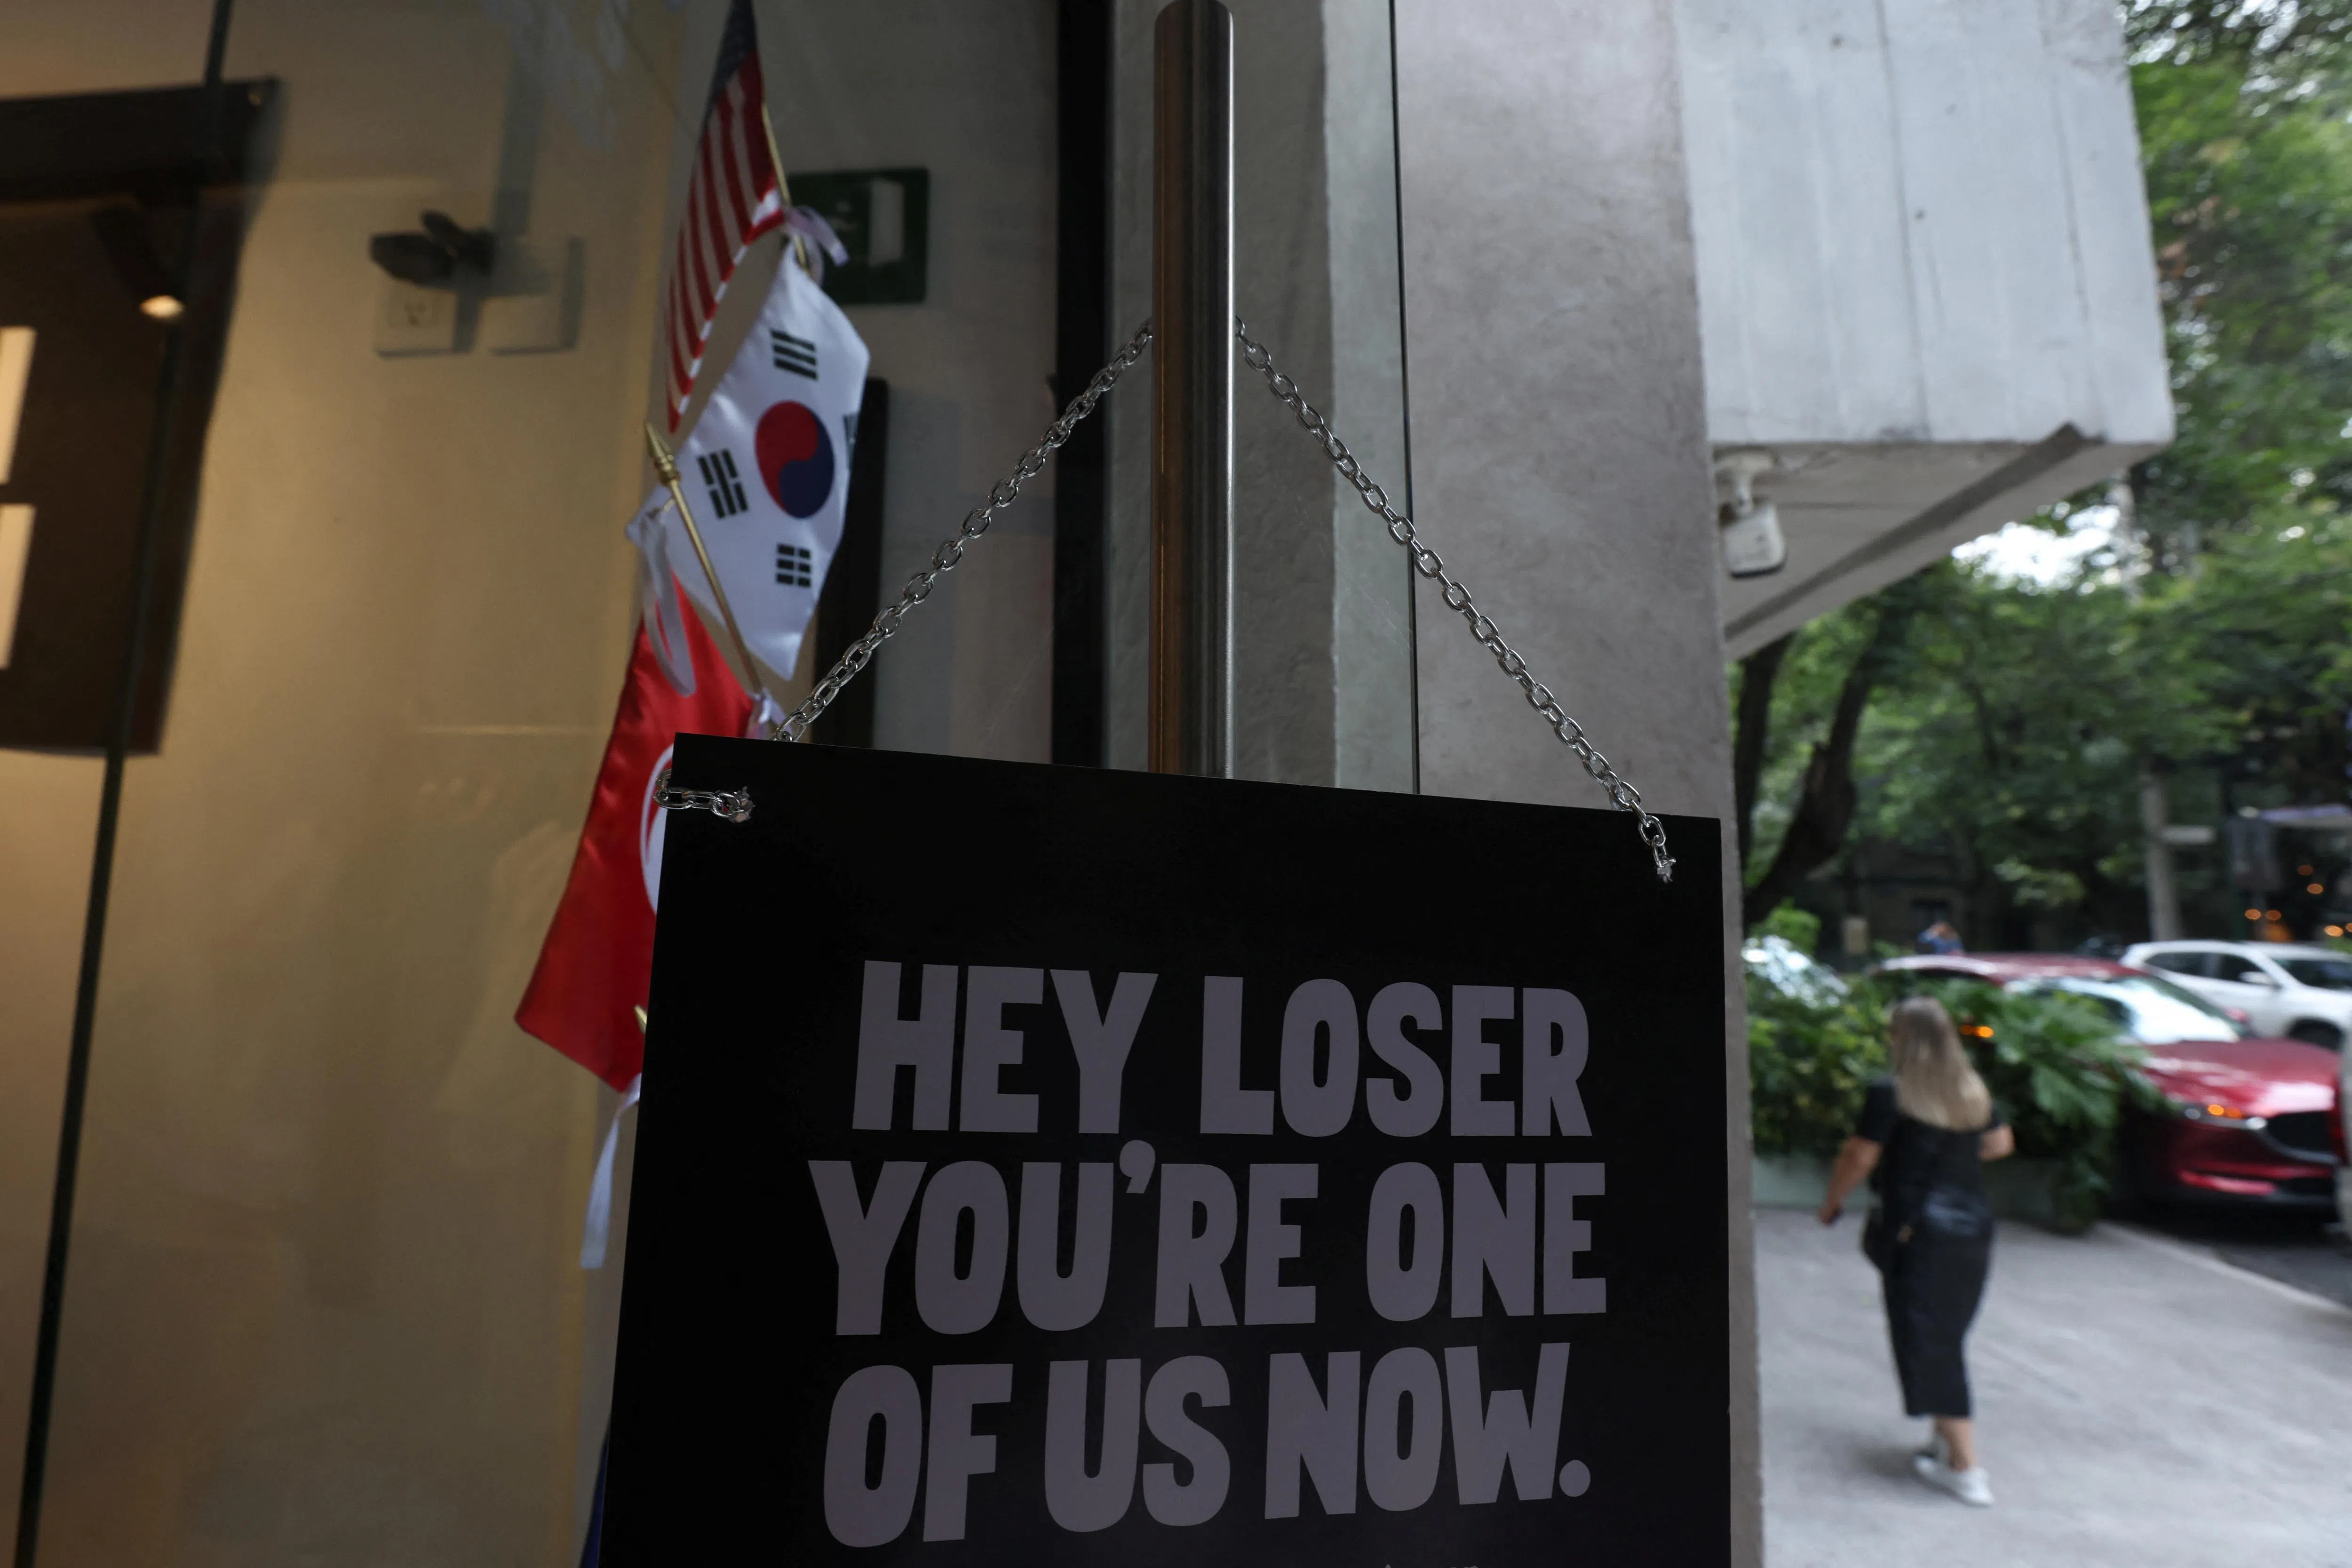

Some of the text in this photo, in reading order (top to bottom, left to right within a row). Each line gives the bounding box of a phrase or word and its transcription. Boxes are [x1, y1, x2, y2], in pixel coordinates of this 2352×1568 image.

[853, 961, 1592, 1137] HEY LOSER
[808, 1140, 1606, 1335] YOU'RE ONE
[824, 1343, 1590, 1547] OF US NOW.
